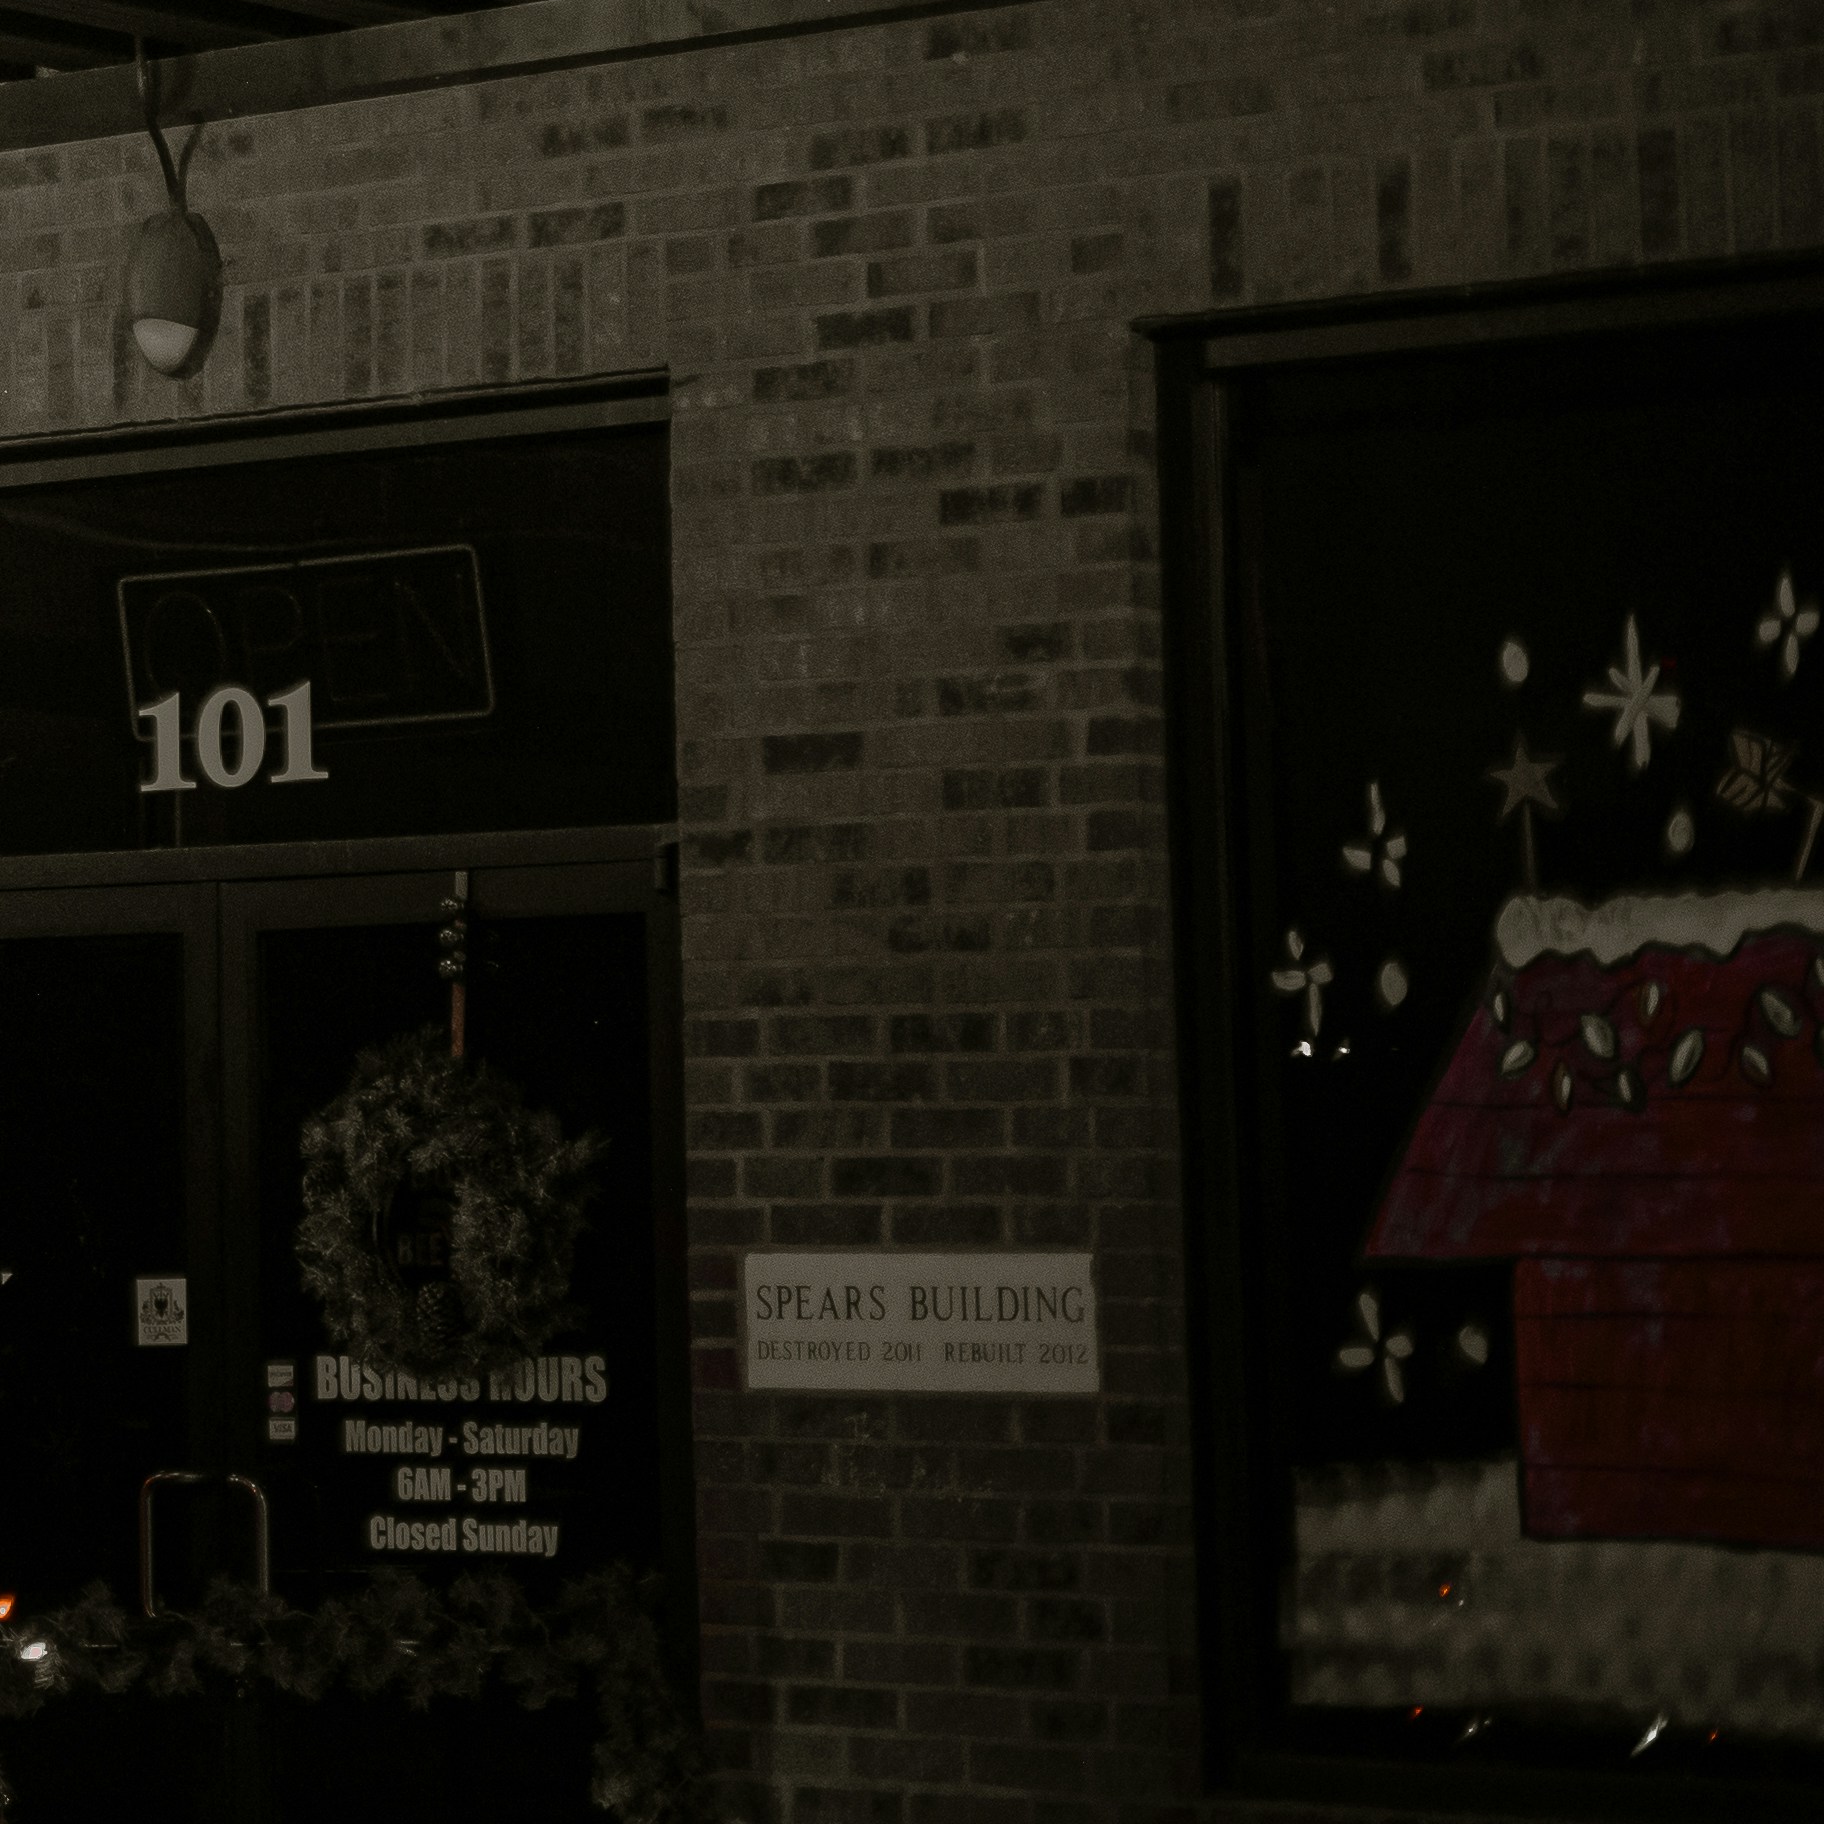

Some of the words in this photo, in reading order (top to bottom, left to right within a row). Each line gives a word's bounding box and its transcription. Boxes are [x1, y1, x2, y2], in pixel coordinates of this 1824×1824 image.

[143, 570, 474, 707] OPEN
[138, 680, 329, 793] 101
[756, 1284, 887, 1321] SPEARS
[910, 1285, 1085, 1323] BUILDING
[757, 1340, 871, 1362] DESTROYED
[882, 1341, 923, 1363] 2011
[944, 1341, 1027, 1364] REBUILT
[1038, 1342, 1090, 1365] 2012
[345, 1420, 443, 1457] Monday
[448, 1436, 458, 1444] -
[462, 1421, 579, 1459] Saturday
[397, 1466, 452, 1502] 6AM
[457, 1484, 467, 1492] -
[471, 1468, 527, 1503] 3PM
[370, 1515, 457, 1552] Closed
[462, 1517, 559, 1558] Sunday
